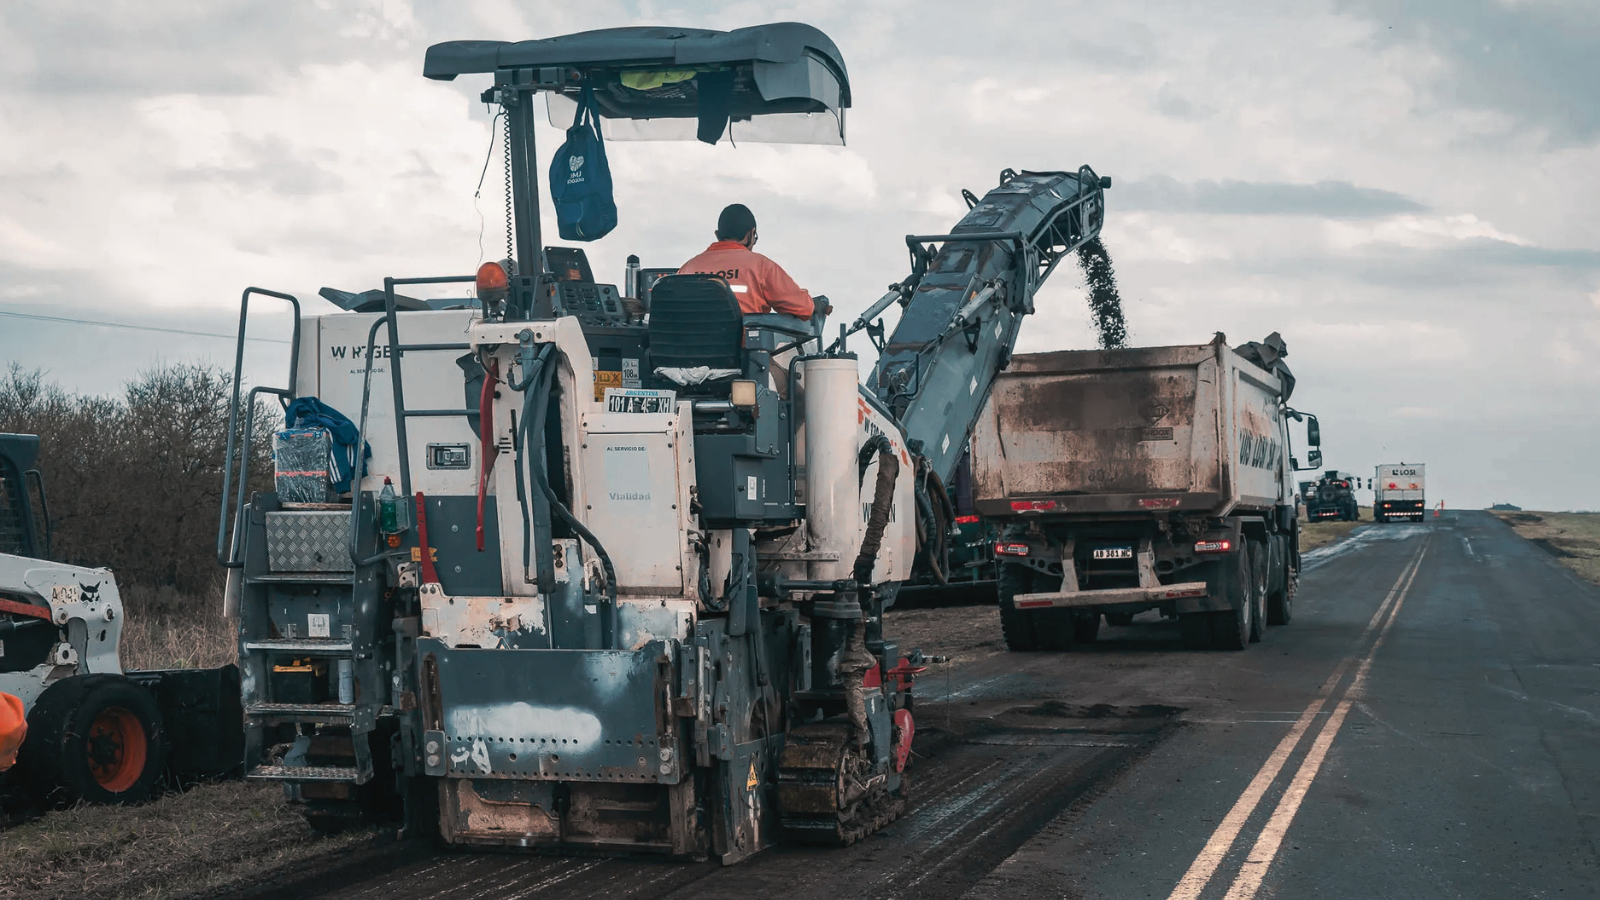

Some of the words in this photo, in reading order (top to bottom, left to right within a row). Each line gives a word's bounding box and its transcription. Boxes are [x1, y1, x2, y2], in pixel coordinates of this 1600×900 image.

[710, 268, 739, 280] OSI
[610, 396, 625, 411] 101
[657, 398, 670, 413] XH
[609, 491, 651, 501] Vialidad
[1095, 550, 1104, 558] AB
